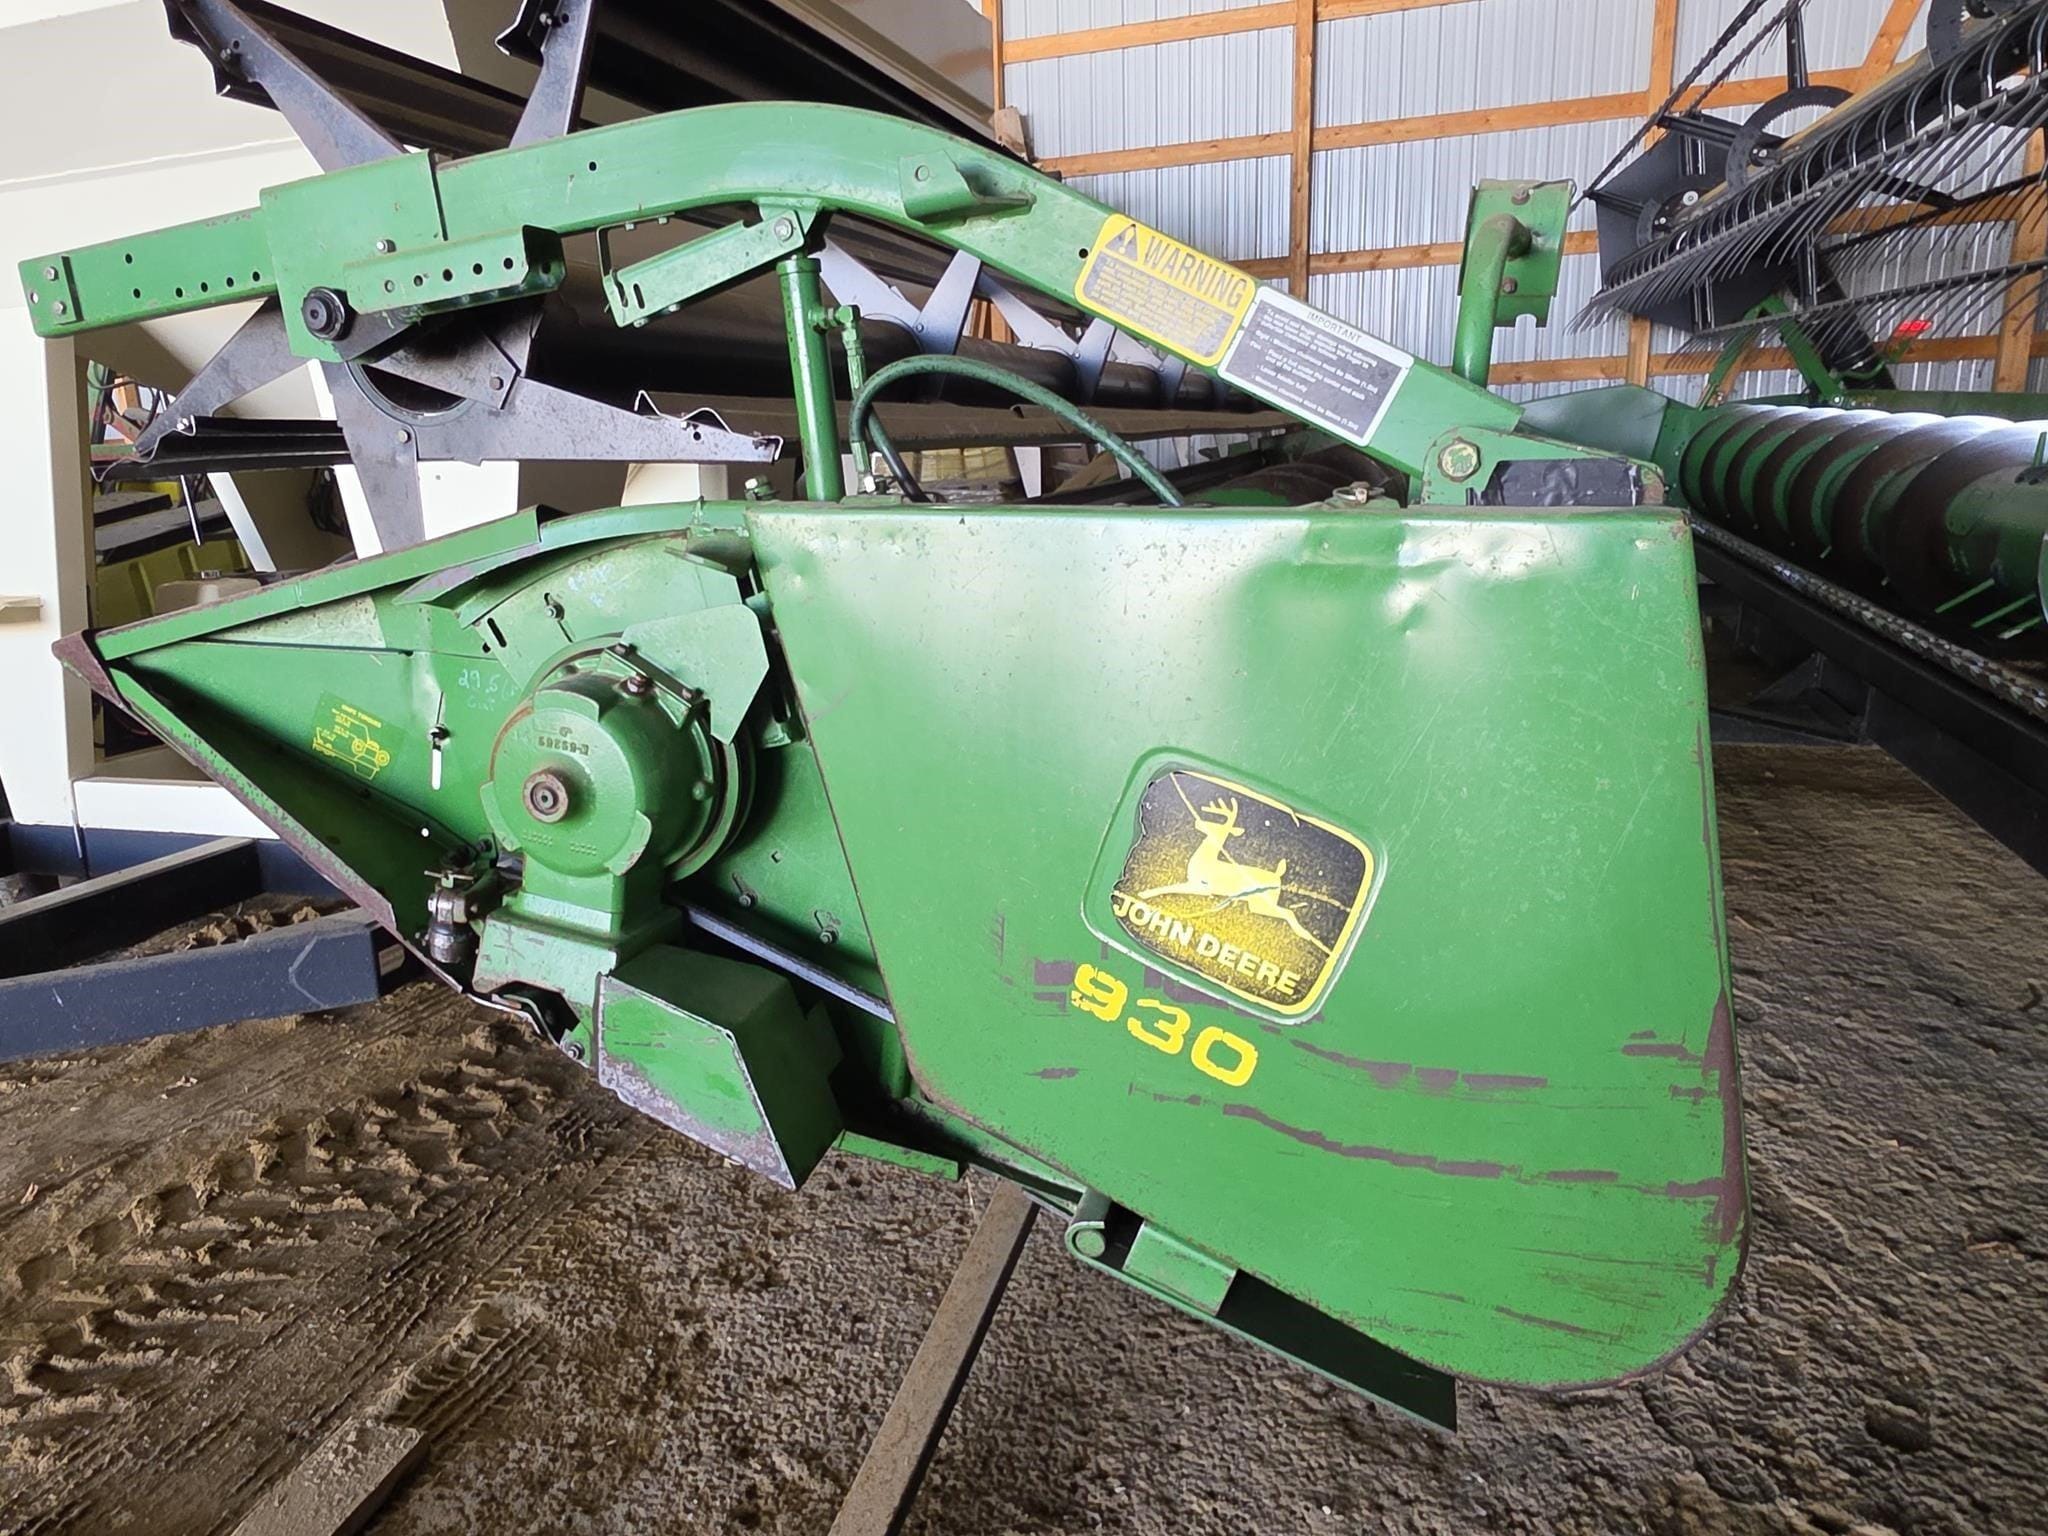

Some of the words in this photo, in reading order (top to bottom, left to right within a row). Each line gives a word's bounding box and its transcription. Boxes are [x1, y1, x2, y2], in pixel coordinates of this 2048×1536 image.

[1144, 236, 1247, 308] WARNING
[1307, 311, 1362, 344] IMPORTANT
[1111, 891, 1193, 948] JOHN
[1196, 933, 1300, 996] DEERE
[1071, 963, 1258, 1086] 930
